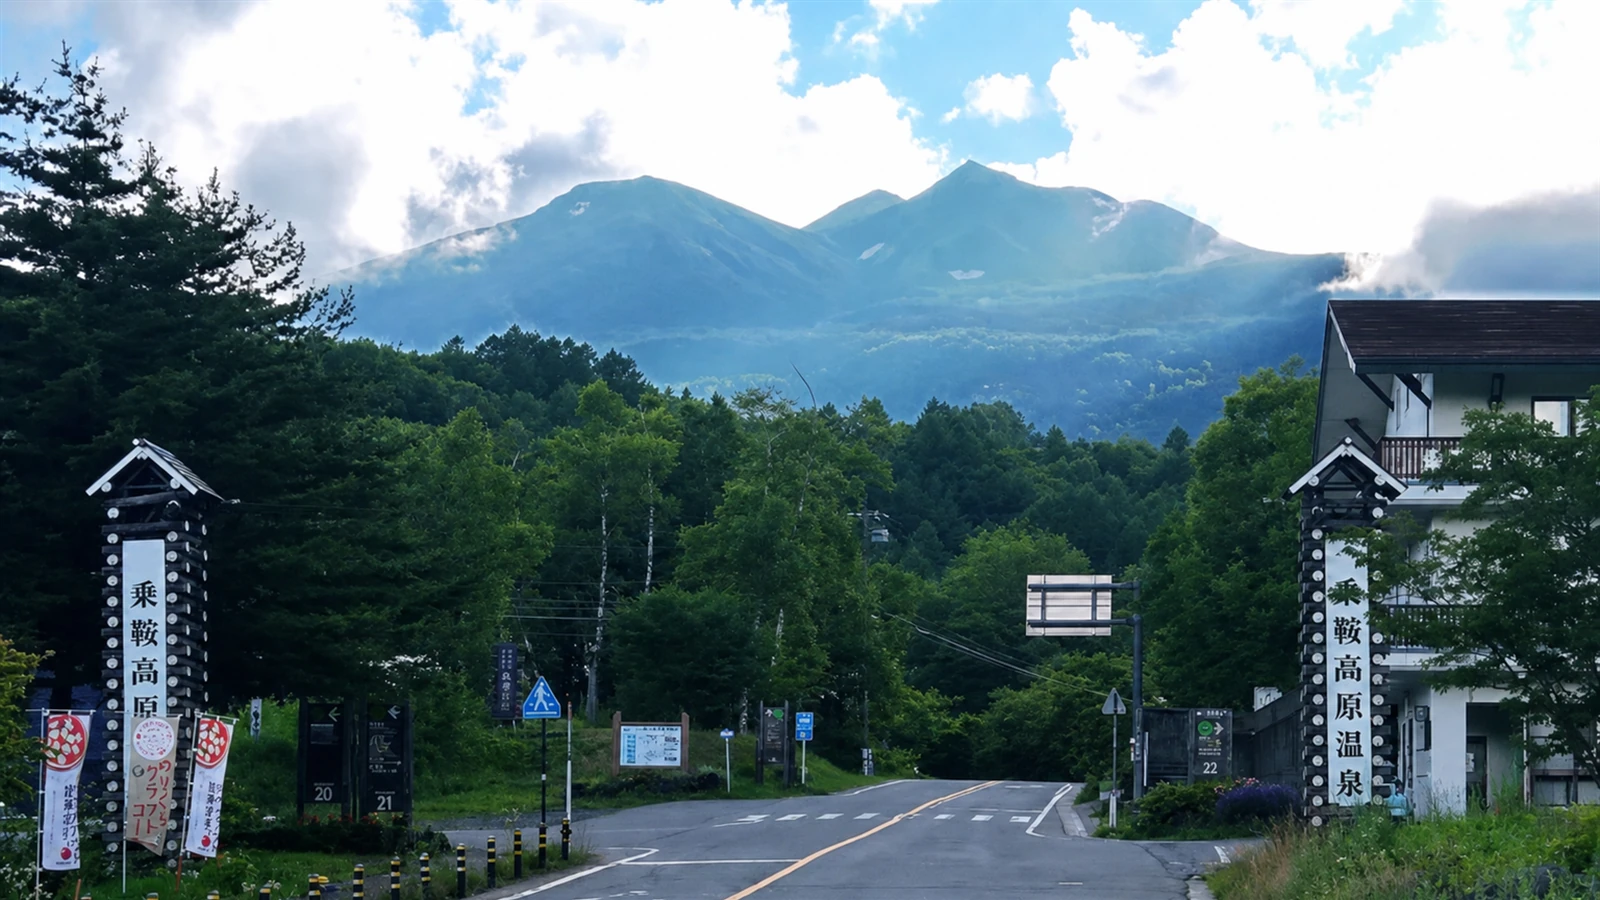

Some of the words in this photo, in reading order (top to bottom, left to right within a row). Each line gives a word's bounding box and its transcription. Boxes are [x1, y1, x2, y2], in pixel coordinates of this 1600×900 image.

[1331, 577, 1364, 797] 乗鞍高原温泉
[1203, 762, 1218, 774] 22
[146, 765, 158, 835] クラフト
[314, 787, 333, 801] 20
[376, 795, 392, 811] 21
